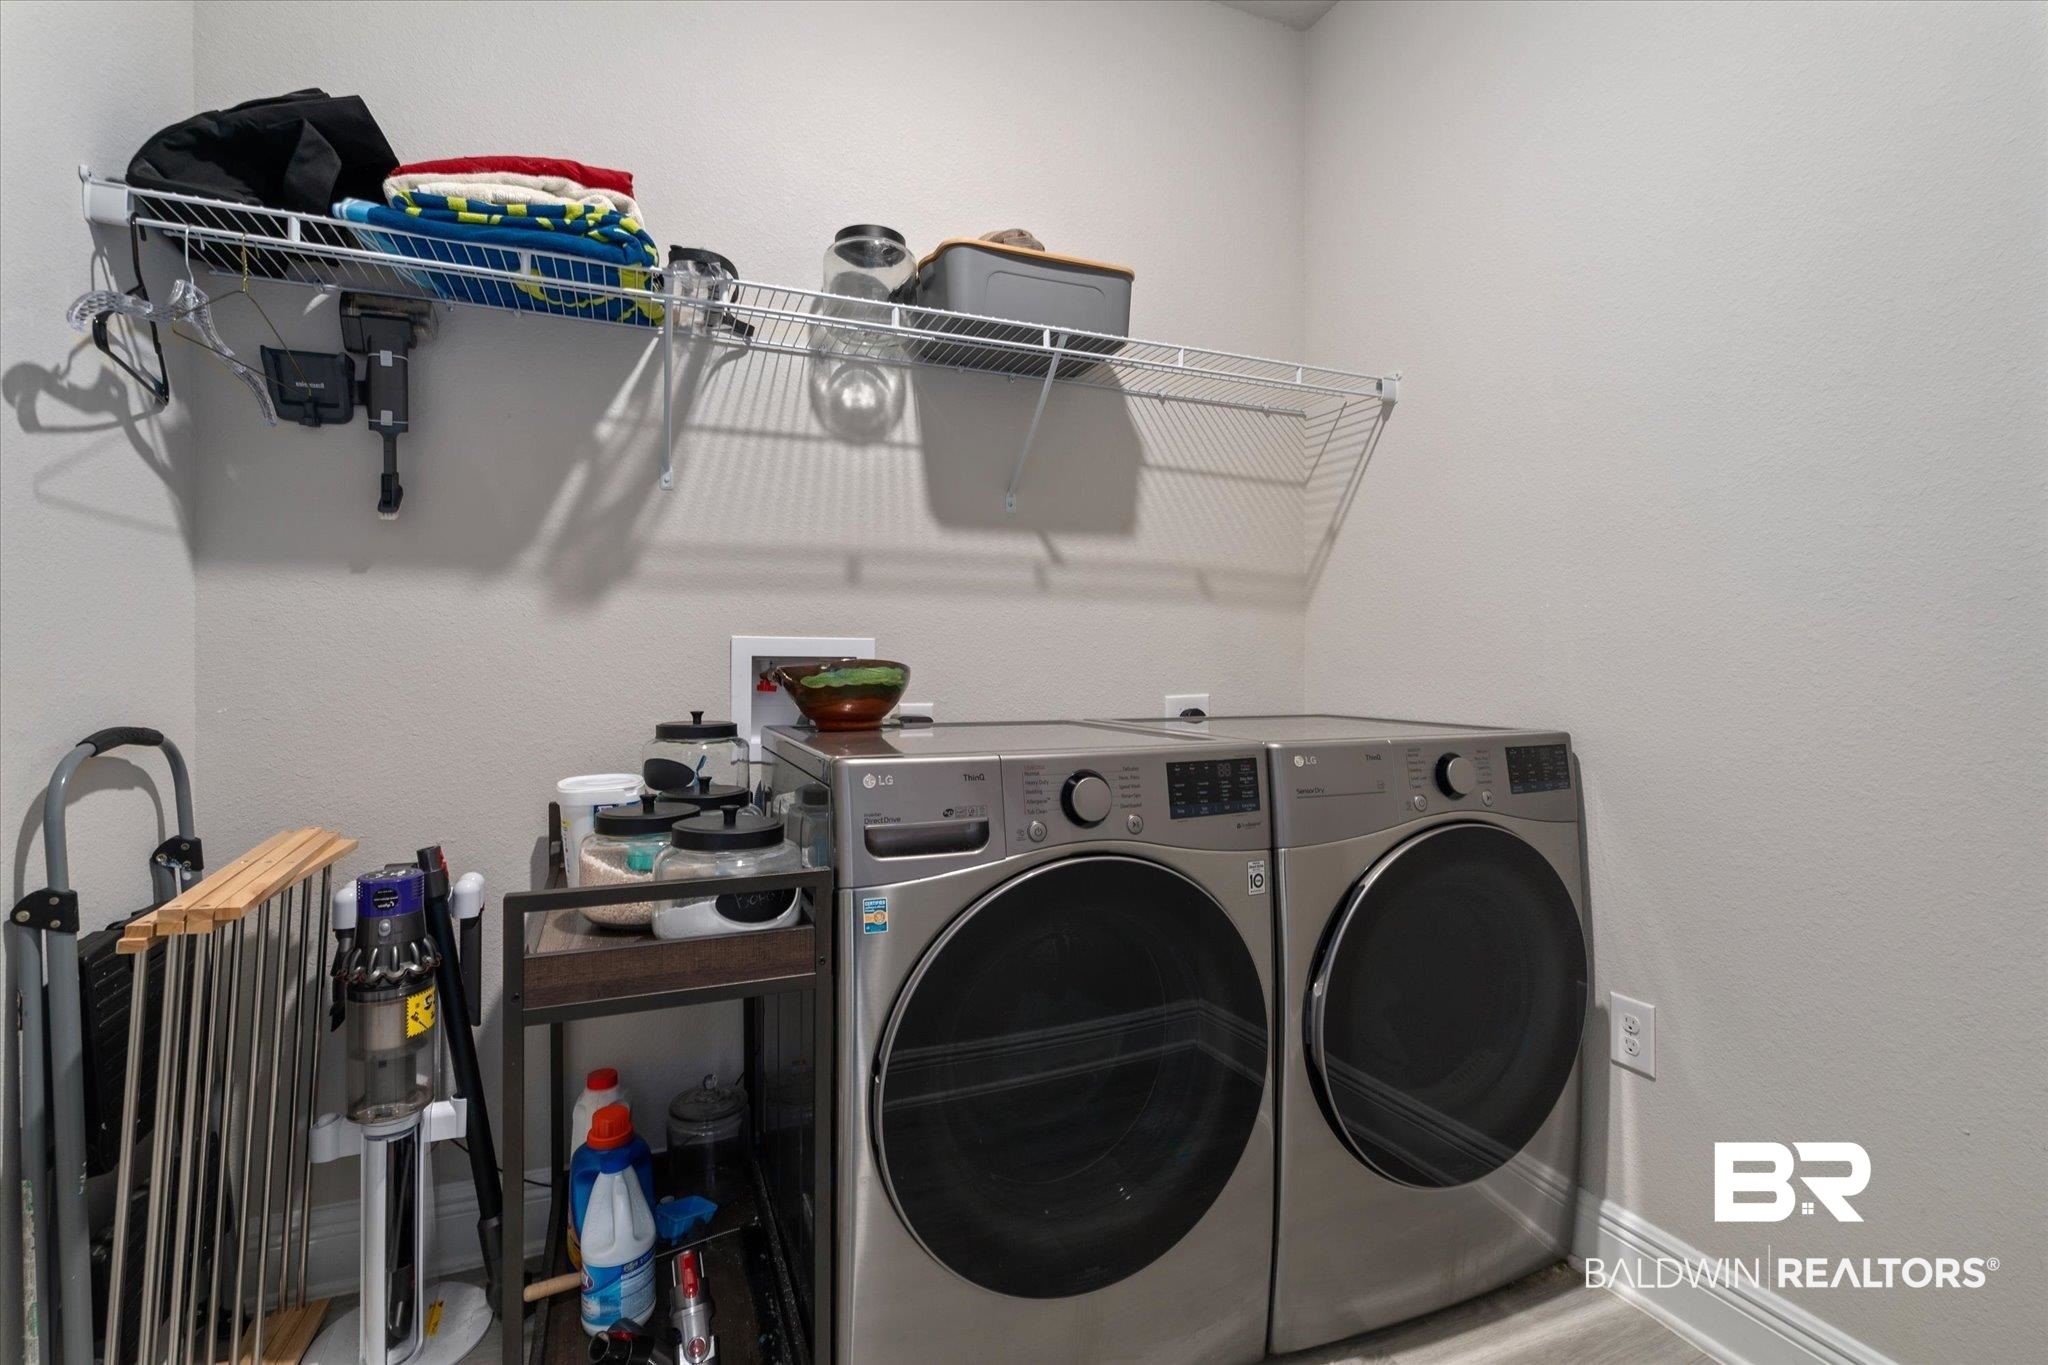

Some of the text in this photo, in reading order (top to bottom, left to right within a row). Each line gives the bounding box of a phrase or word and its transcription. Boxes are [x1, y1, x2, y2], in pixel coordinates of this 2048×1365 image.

[1365, 753, 1383, 761] ThinQ
[963, 772, 985, 782] ThinQ
[1249, 873, 1264, 889] 10
